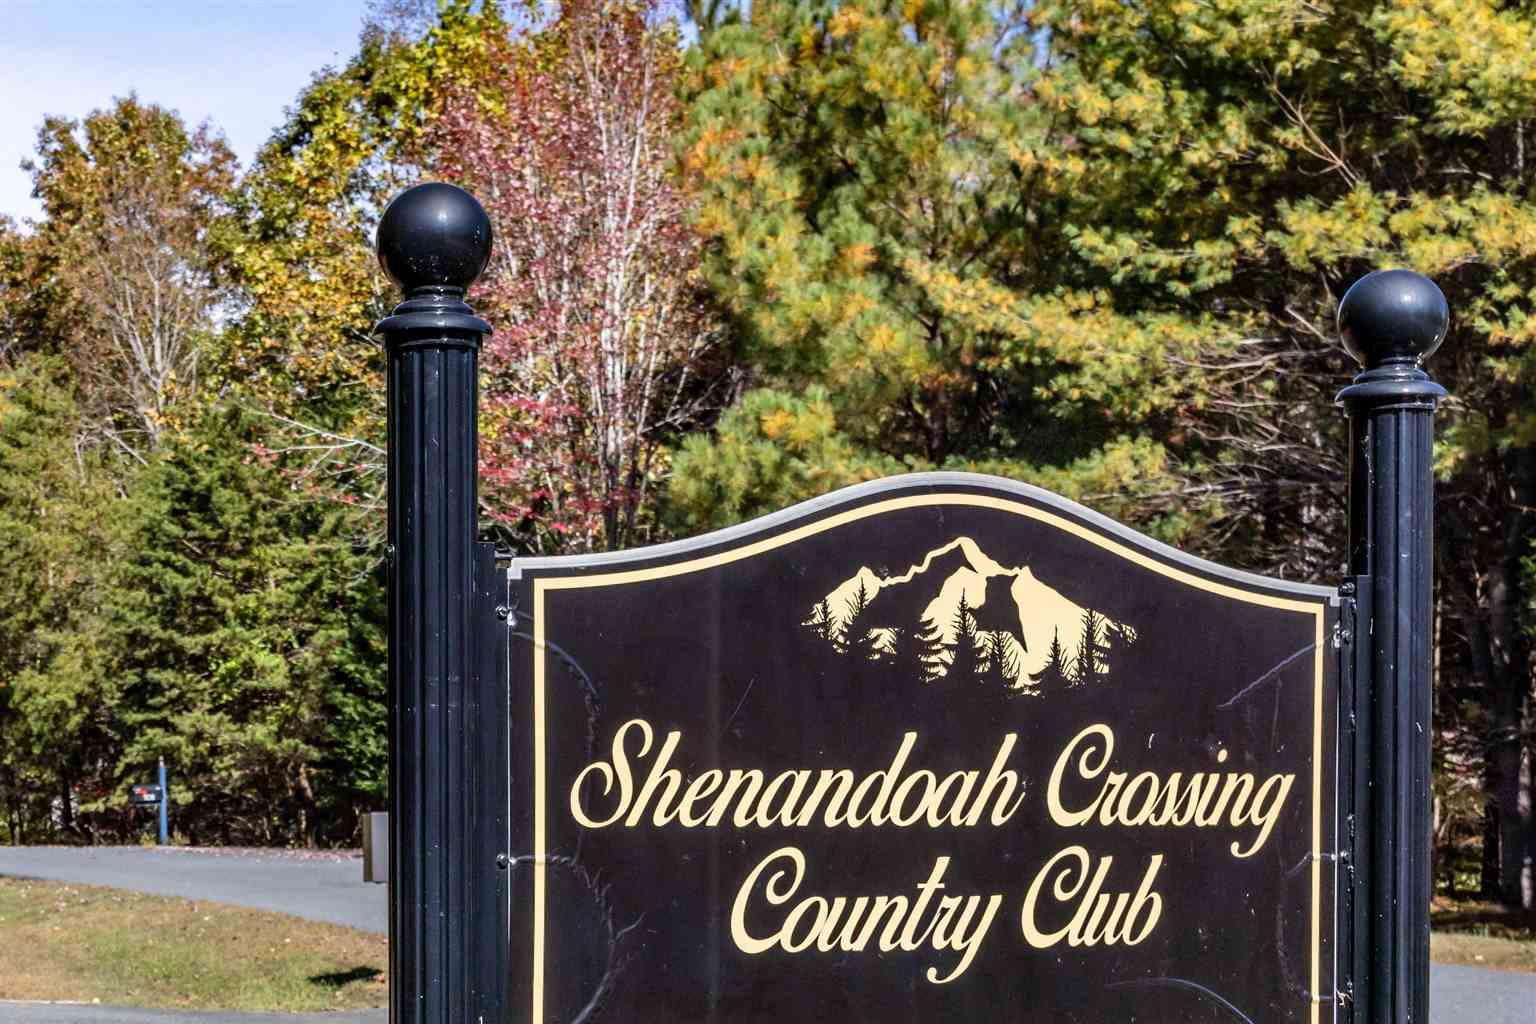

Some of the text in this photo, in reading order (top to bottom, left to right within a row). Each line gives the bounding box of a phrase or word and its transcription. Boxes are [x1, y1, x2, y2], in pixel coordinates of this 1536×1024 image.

[570, 718, 1296, 858] Shenandoah Crossing
[730, 845, 1164, 984] Country Club
